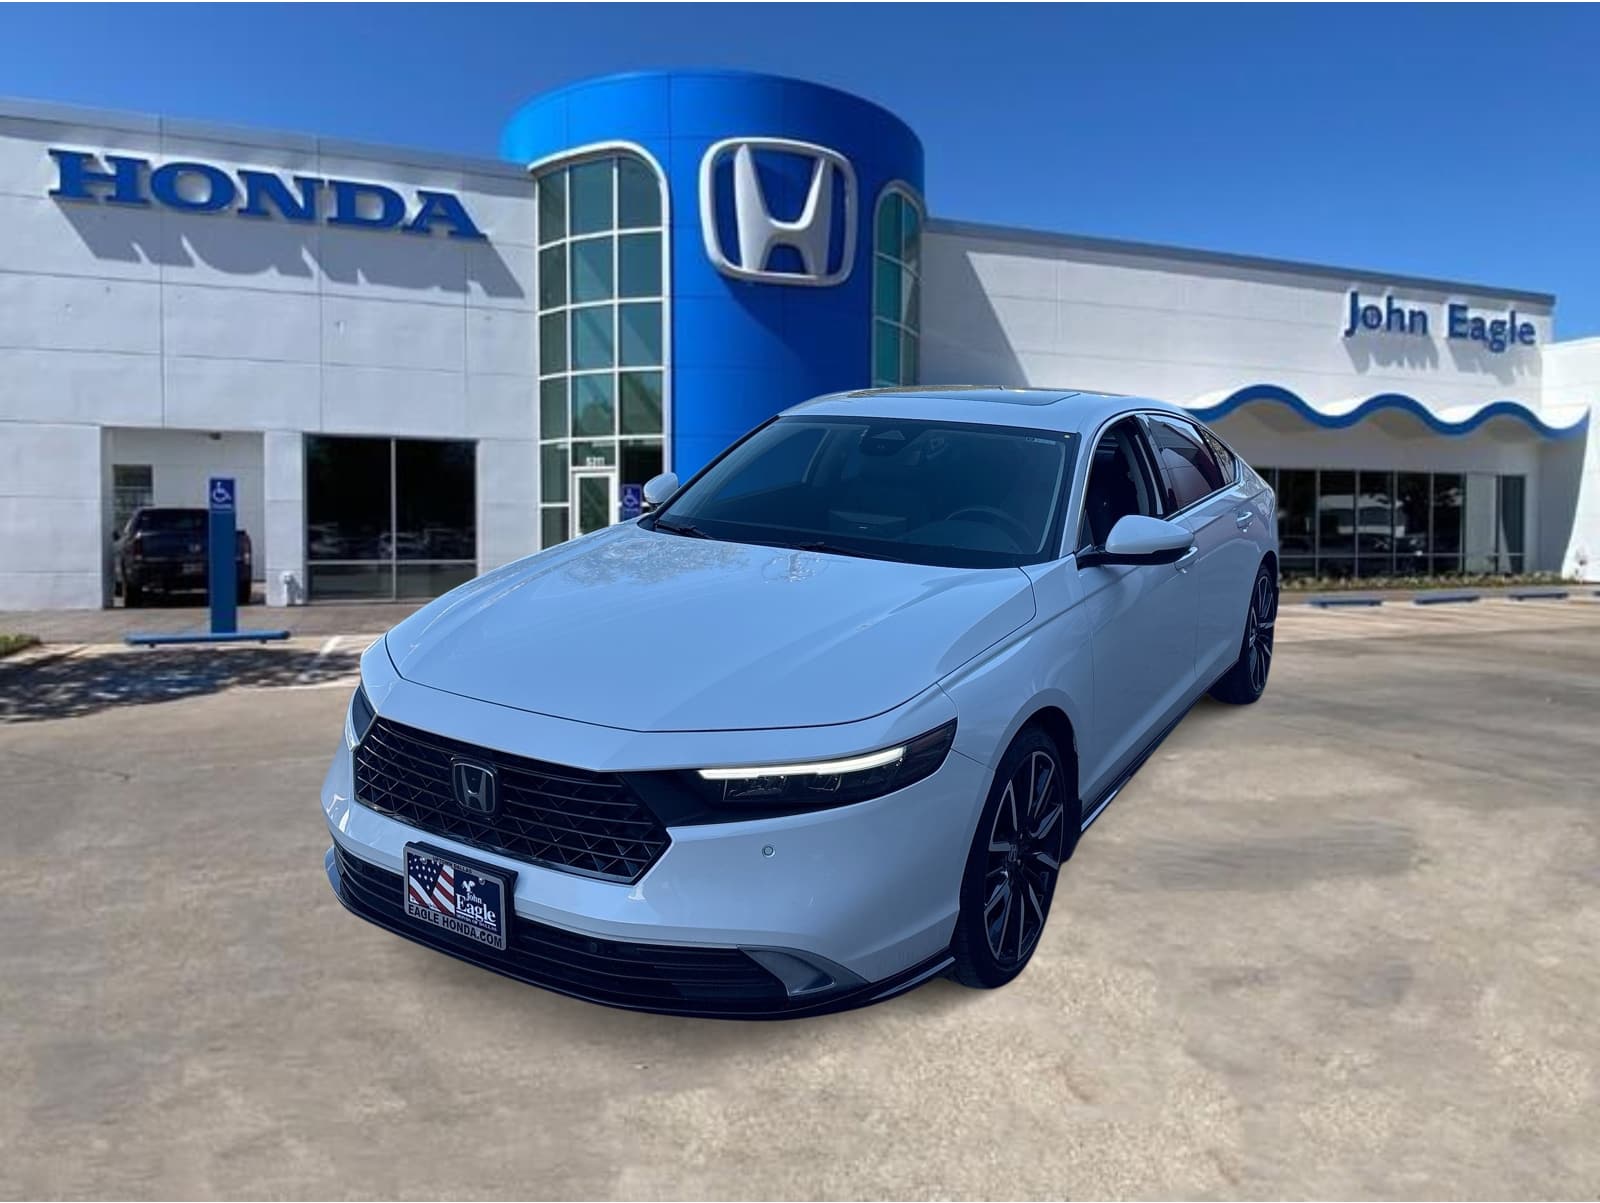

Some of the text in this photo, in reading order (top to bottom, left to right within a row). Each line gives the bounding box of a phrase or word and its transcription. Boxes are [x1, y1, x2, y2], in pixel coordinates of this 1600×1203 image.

[48, 148, 488, 241] HONDA
[1343, 291, 1536, 353] John Eagle
[456, 893, 497, 923] Eagle
[465, 892, 483, 904] John
[408, 903, 502, 947] EAGLE HONDA.COM
